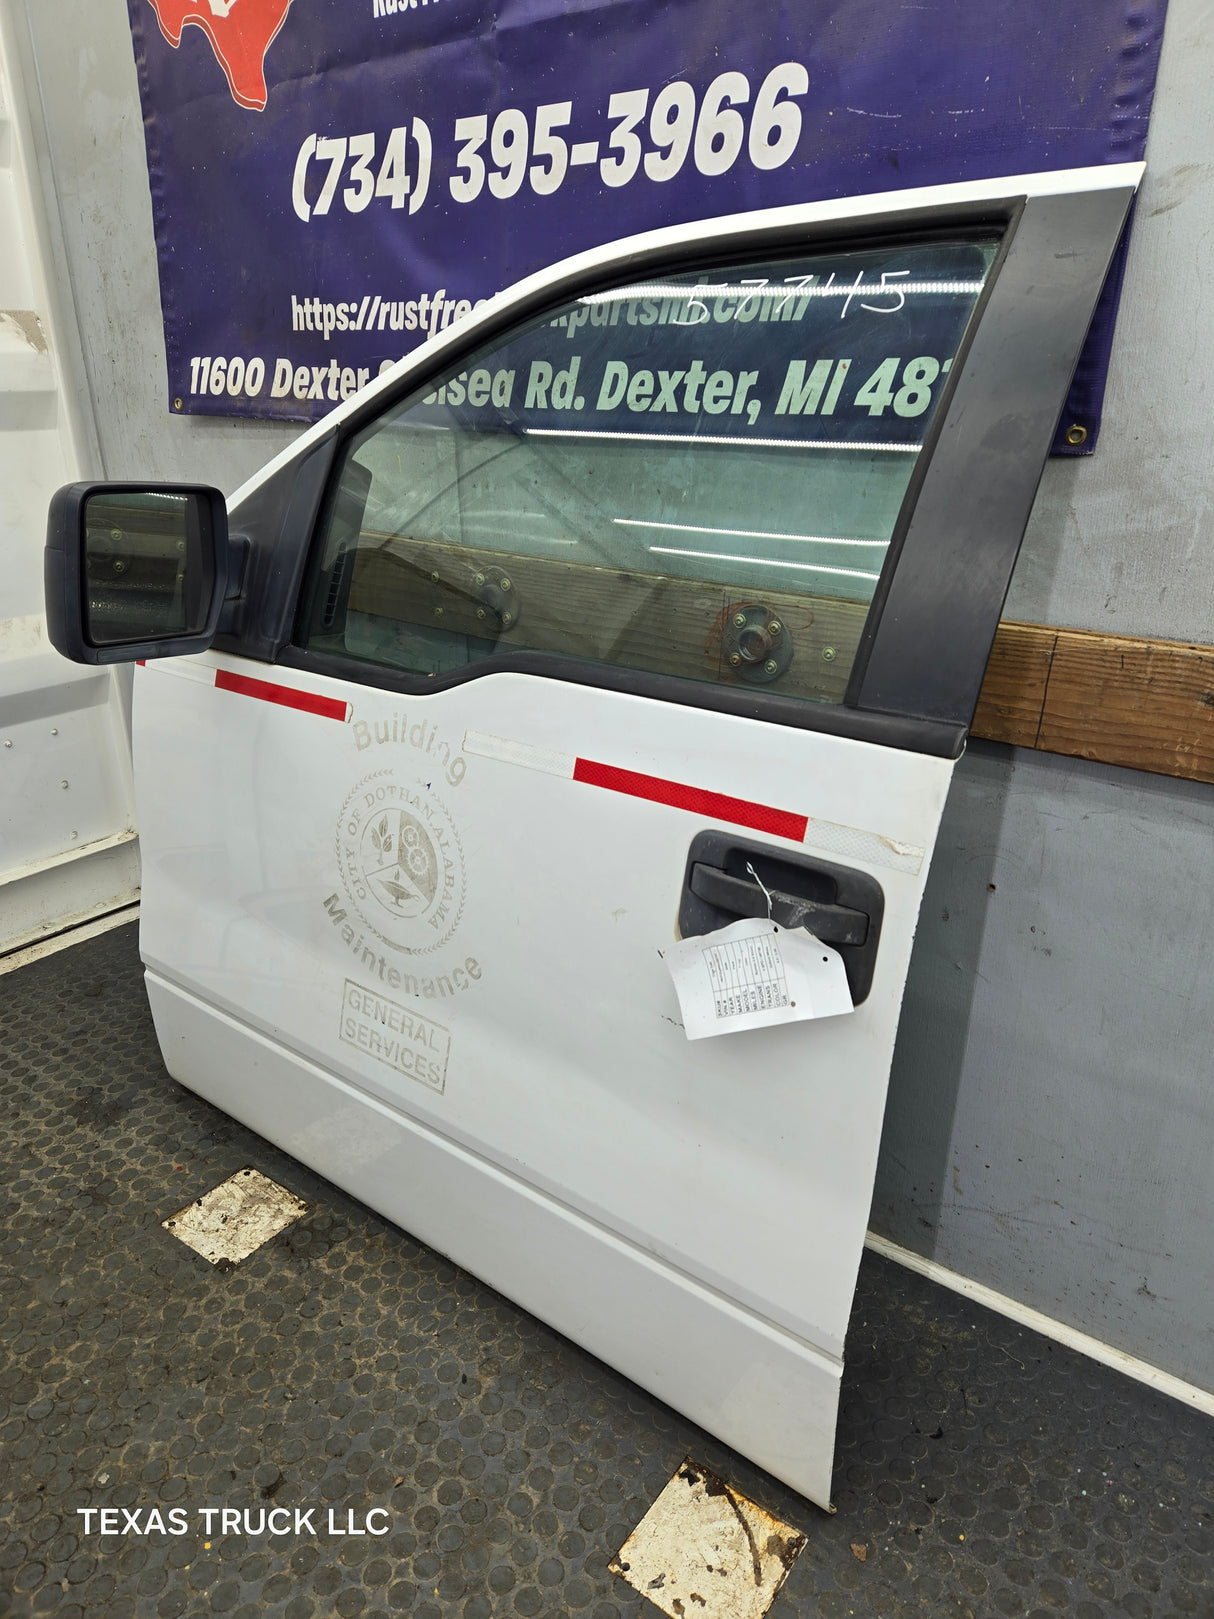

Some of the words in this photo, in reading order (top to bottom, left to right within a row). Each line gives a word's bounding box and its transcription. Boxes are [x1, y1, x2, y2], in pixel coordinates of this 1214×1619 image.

[291, 117, 432, 222] (734)
[449, 62, 809, 203] 395-3966
[189, 357, 265, 395] 11600
[271, 358, 369, 401] Dexter
[524, 361, 585, 413] Rd.
[596, 360, 758, 425] Dexter,
[775, 359, 852, 416] MI
[854, 356, 954, 417] 48
[352, 712, 467, 787] Building
[347, 808, 361, 836] OF
[346, 848, 366, 900] CITY
[428, 826, 454, 929] ALABAMA
[323, 893, 482, 999] Maintenance
[345, 1017, 440, 1084] SERVICES
[348, 989, 440, 1053] GENERAL
